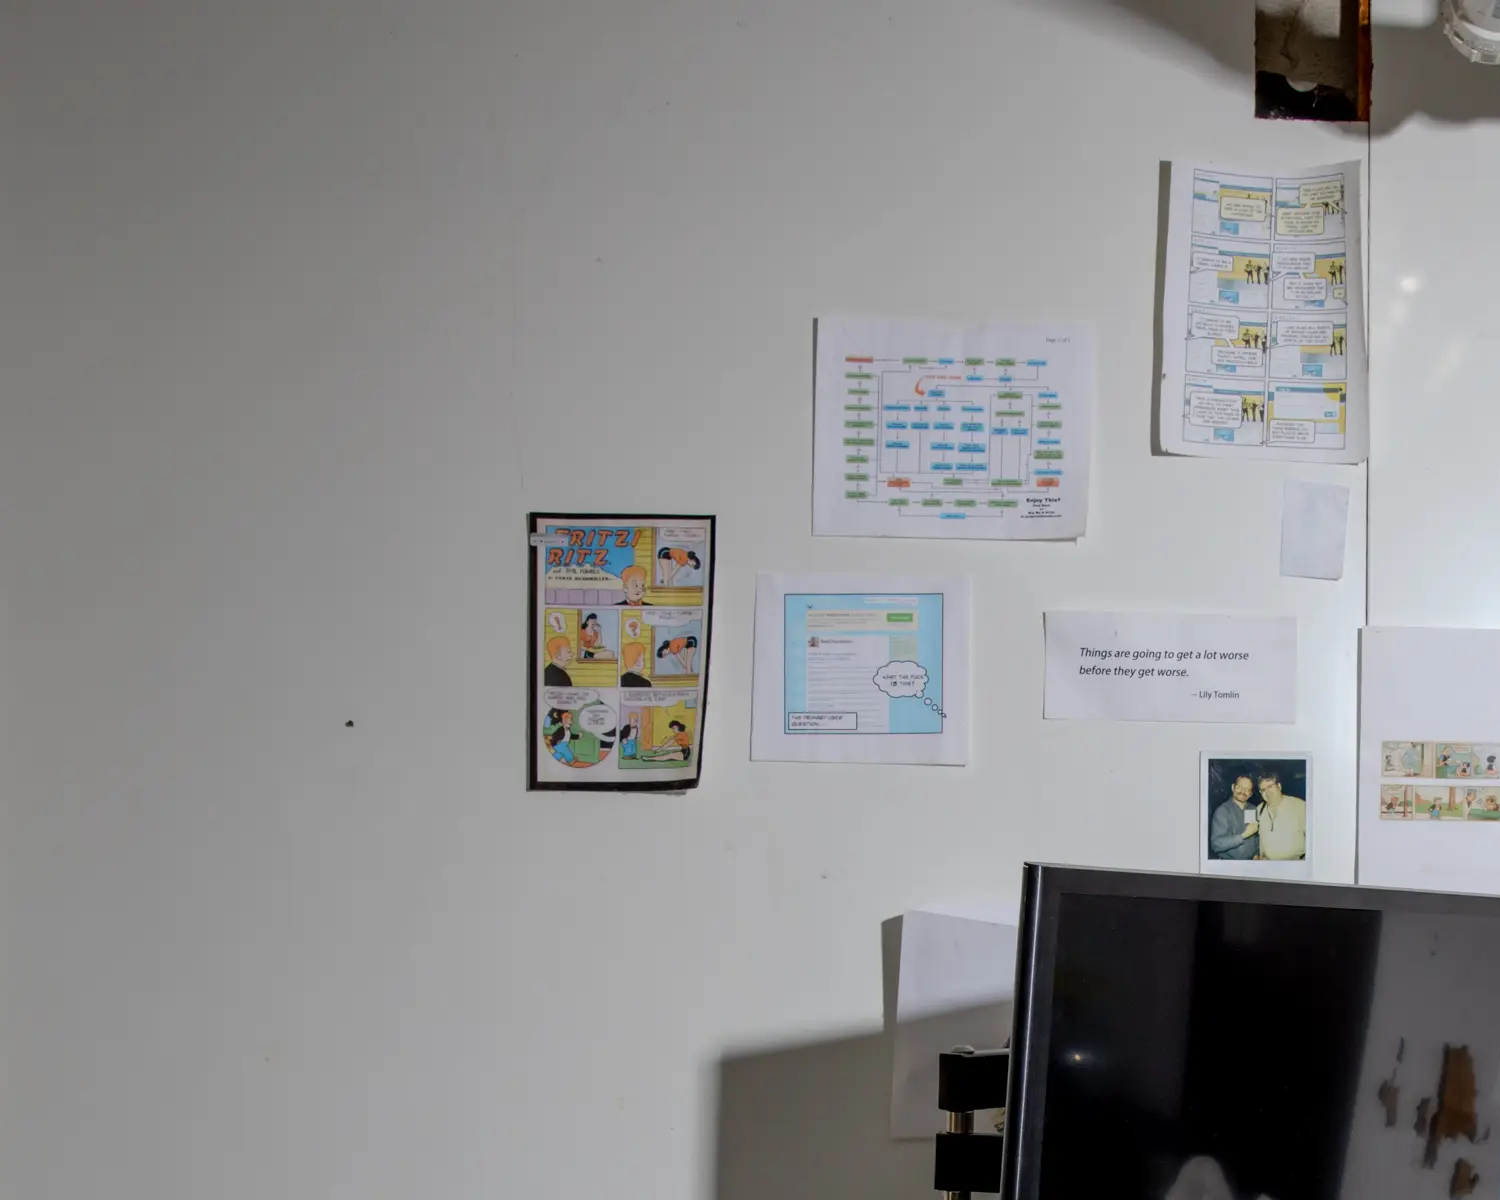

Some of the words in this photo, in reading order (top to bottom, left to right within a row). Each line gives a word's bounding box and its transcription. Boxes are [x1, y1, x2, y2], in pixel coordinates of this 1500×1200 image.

[547, 547, 609, 567] RITZ
[1080, 647, 1112, 659] Things
[1132, 650, 1161, 661] going
[1164, 650, 1174, 659] to
[1176, 651, 1193, 662] get
[1203, 650, 1217, 660] lot
[1219, 652, 1249, 660] worse
[1079, 665, 1111, 676] before
[1114, 666, 1135, 678] they
[1138, 668, 1155, 678] get
[1157, 668, 1189, 677] worse.
[1199, 690, 1212, 699] Lily
[1214, 690, 1240, 699] Tomlin
